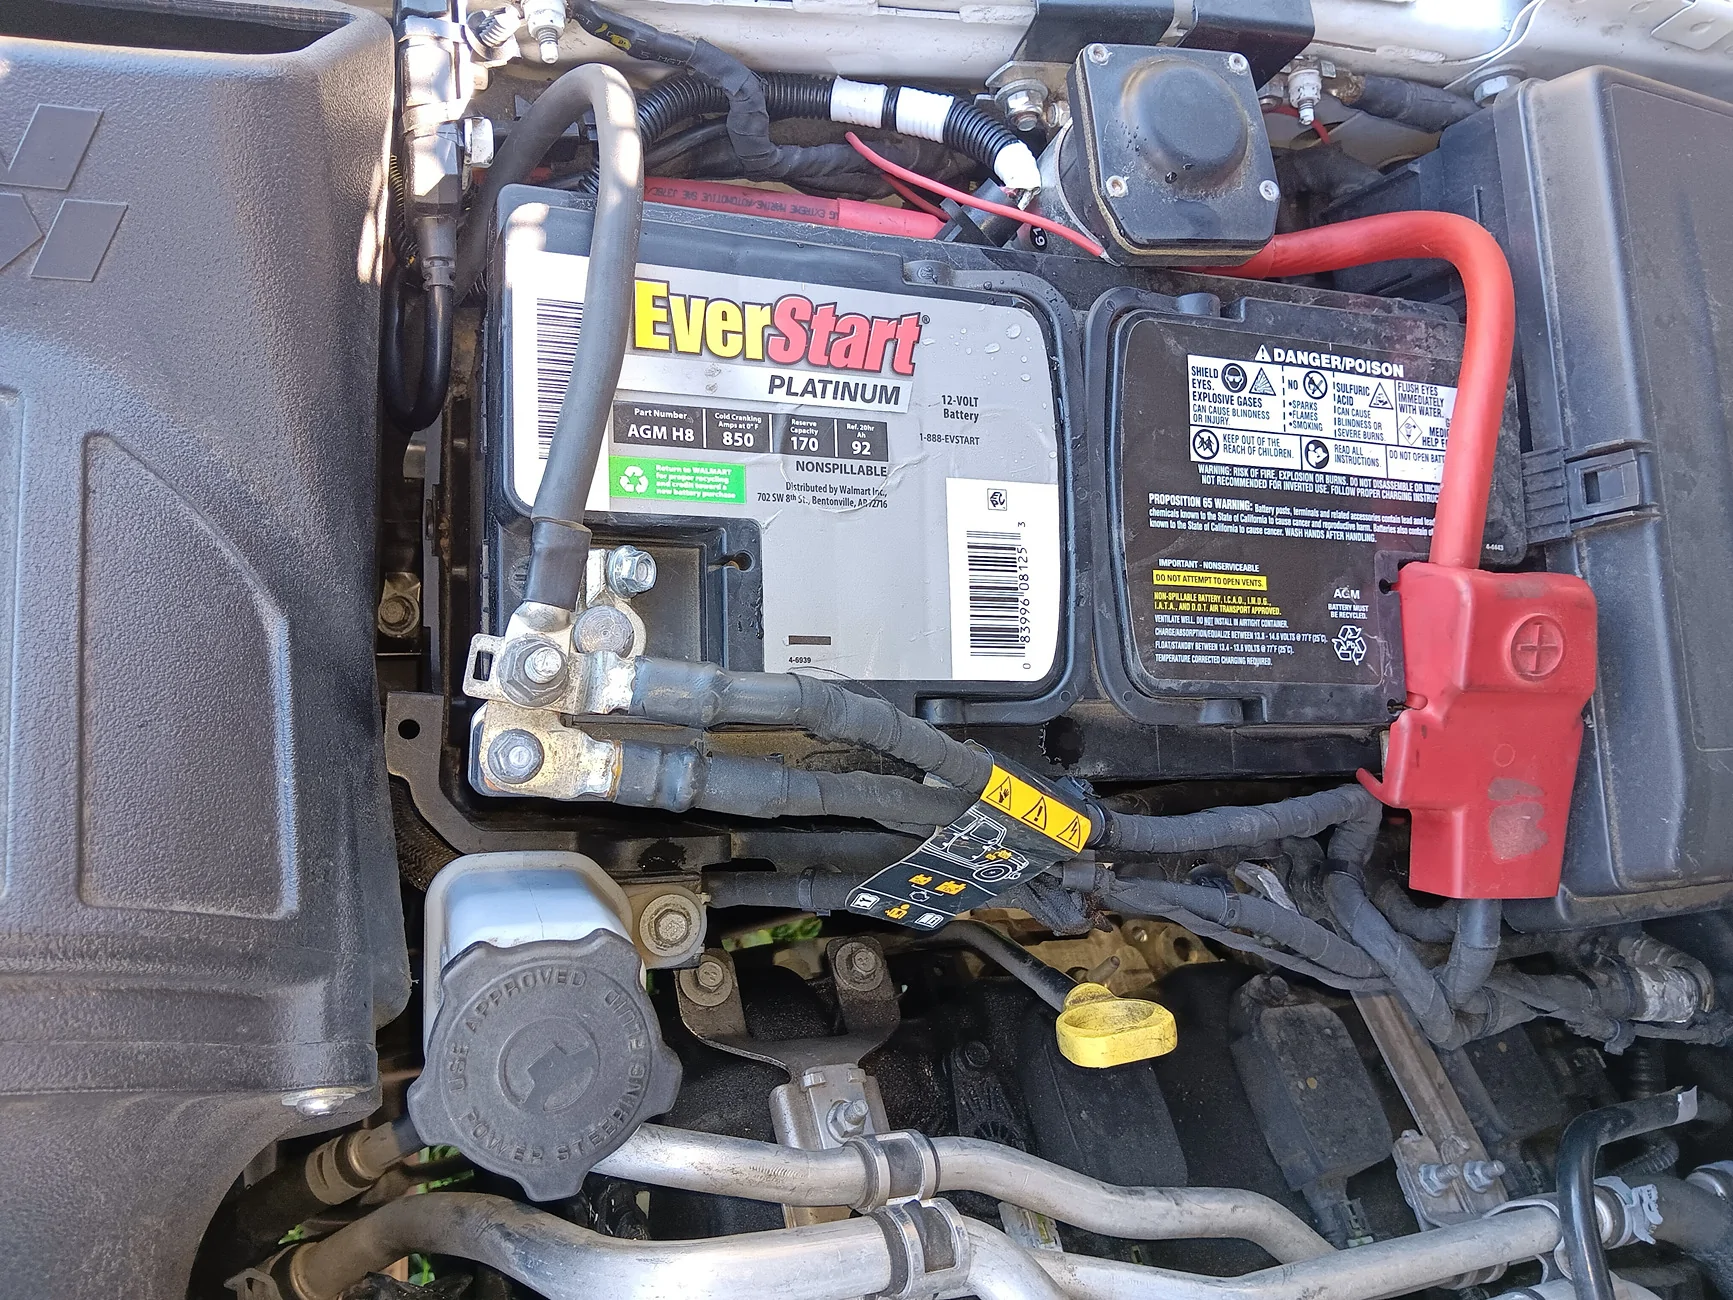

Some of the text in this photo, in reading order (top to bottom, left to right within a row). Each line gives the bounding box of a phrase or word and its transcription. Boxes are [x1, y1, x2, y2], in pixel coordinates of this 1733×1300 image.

[790, 205, 826, 218] EXTREME
[634, 277, 922, 377] EverStart
[1273, 347, 1404, 378] DANGER/POISON
[1191, 365, 1219, 379] SHIELD
[768, 375, 900, 405] PLATINUM
[1192, 378, 1215, 391] EYES.
[1287, 379, 1299, 390] NO
[1336, 382, 1370, 397] SULFURIC
[1397, 382, 1438, 396] FLUSH EYES
[941, 394, 979, 408] 12-VOLT
[1192, 391, 1263, 409] EXPLOSIVE GASES
[1292, 400, 1318, 411] SPARKS
[1336, 394, 1354, 406] ACID
[1398, 392, 1444, 408] IMMEDIATELY
[634, 407, 687, 420] Part Number
[943, 408, 979, 423] Battery
[1192, 403, 1270, 420] CAN CAUSE BLINDNESS
[1292, 410, 1318, 421] FLAMES
[1337, 406, 1371, 419] CAN CAUSE
[1399, 403, 1444, 418] WITH WATER.
[714, 412, 762, 424] Cold Cranking
[791, 418, 817, 427] Reserve
[1193, 413, 1231, 426] OR INJURY.
[1337, 417, 1382, 431] BLINDNESS OR
[628, 423, 695, 442] AGM H8
[718, 421, 738, 430] Amps
[790, 426, 819, 436] Capacity
[846, 422, 875, 432] Ref. 20hr
[1292, 420, 1323, 432] SMOKING
[722, 431, 754, 447] 850
[919, 433, 980, 445] 1-888-EVSTART
[1222, 433, 1281, 447] KEEP OUT OF THE
[1337, 428, 1386, 442] SEVERE BURNS.
[1422, 436, 1439, 447] HELP
[790, 436, 819, 451] 170
[851, 440, 871, 455] 92
[1334, 444, 1363, 456] READ ALL
[1223, 443, 1294, 459] REACH OF CHILDREN.
[1389, 449, 1398, 459] DO
[1399, 450, 1411, 461] NOT
[1412, 452, 1429, 462] OPEN
[1334, 454, 1382, 468] INSTRUCTIONS.
[692, 467, 732, 475] WALMART
[796, 460, 887, 477] NONSPILLABLE
[1197, 464, 1232, 476] WARNING:
[1233, 467, 1249, 477] RISK
[1250, 468, 1259, 478] OF
[1260, 469, 1278, 481] FIRE,
[1279, 470, 1314, 482] EXPLOSION
[1315, 473, 1324, 483] OR
[1325, 474, 1348, 486] BURNS.
[1349, 477, 1358, 487] DO
[1359, 478, 1372, 488] NOT
[1373, 479, 1414, 492] DISASSEMBLE
[1414, 483, 1424, 493] OR
[786, 481, 827, 493] Distributed
[828, 484, 838, 495] by
[839, 485, 871, 497] Walmart
[1201, 475, 1412, 502] NOT RECOMMENDED FOR INVERTED USE. FOLLOW PROPER CHARGING
[757, 492, 770, 501] 702
[772, 493, 784, 502] SW
[785, 493, 796, 503] 8th
[812, 495, 856, 508] Bentonville,
[1149, 493, 1253, 511] PROPOSITION 65 WARNING:
[1285, 527, 1377, 543] WASH HANDS AFTER HANDLING.
[1017, 547, 1029, 591] 08125
[1158, 558, 1260, 572] IMPORTANT NONSERVICEABLE
[1155, 573, 1264, 587] DO NOT ATTEMPT TO OPEN VENTS.
[1153, 591, 1223, 604] NON-SPILLABLE BATTERY,
[1333, 588, 1360, 600] AGM
[1178, 602, 1190, 611] AND
[1209, 604, 1219, 613] AIR
[1219, 605, 1251, 614] TRANSPORT
[1251, 606, 1282, 616] APPROVED.
[1327, 603, 1369, 612] BATTERY MUST
[1019, 598, 1031, 643] 83996
[1339, 611, 1368, 619] RECYCLED.
[1345, 641, 1355, 649] Pb
[447, 967, 588, 1094] USE APPROVED
[459, 988, 646, 1163] POWER STEERING FLUID
